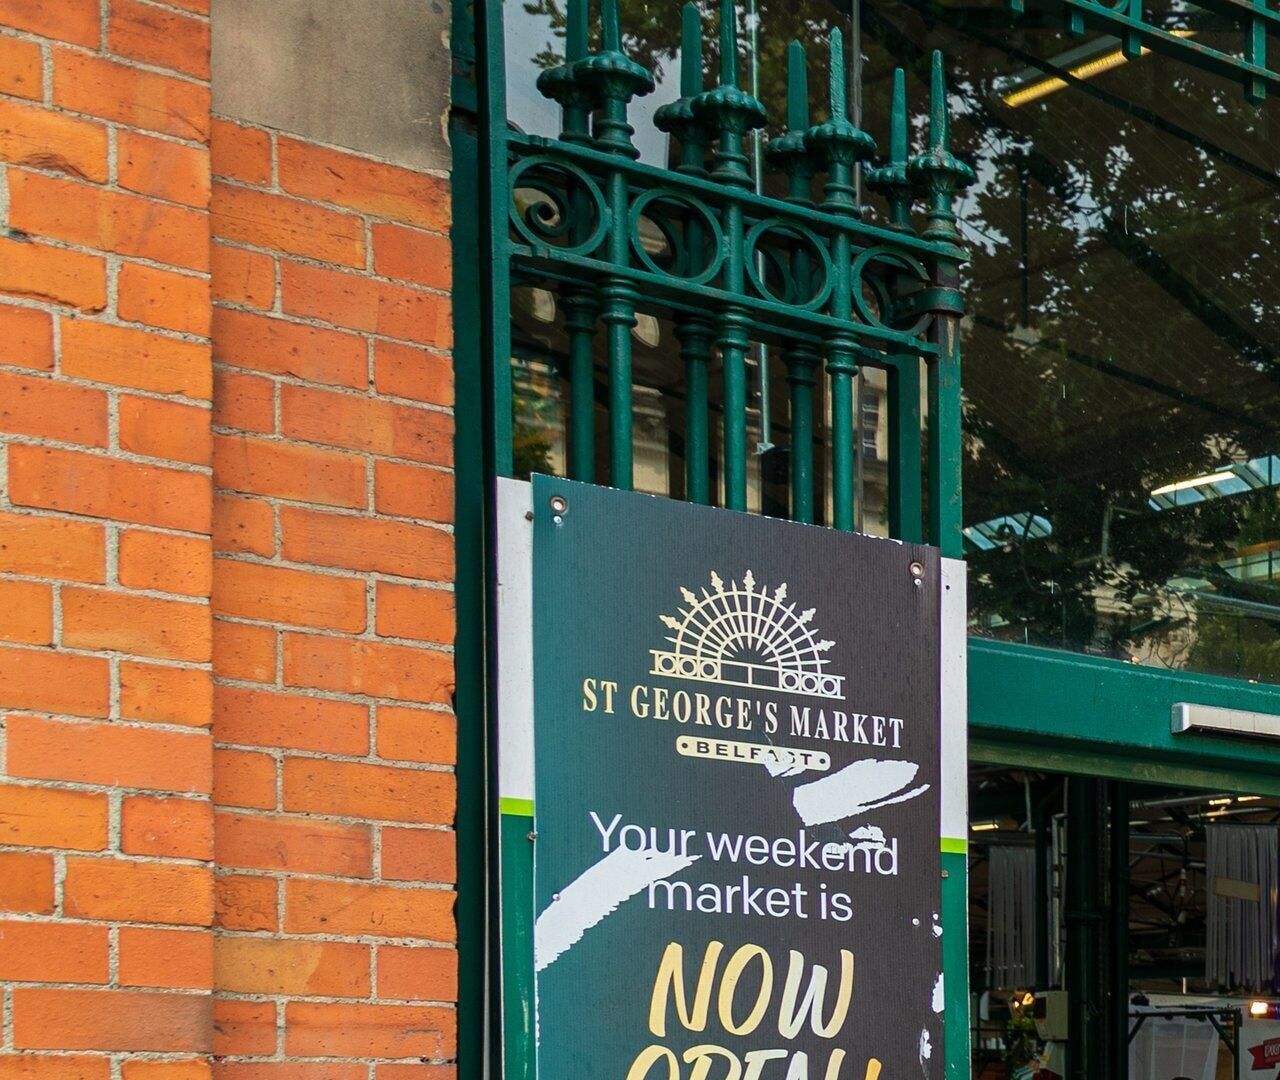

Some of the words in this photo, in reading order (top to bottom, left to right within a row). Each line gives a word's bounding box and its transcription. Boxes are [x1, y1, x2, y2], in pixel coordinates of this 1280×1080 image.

[582, 677, 618, 714] ST
[630, 685, 778, 735] GEORGE'S
[790, 704, 904, 749] MARKET
[696, 740, 812, 768] BELFAST
[590, 811, 698, 856] Your
[706, 830, 899, 877] weekend
[648, 875, 807, 921] market
[821, 886, 853, 922] is
[648, 940, 855, 1040] NOW
